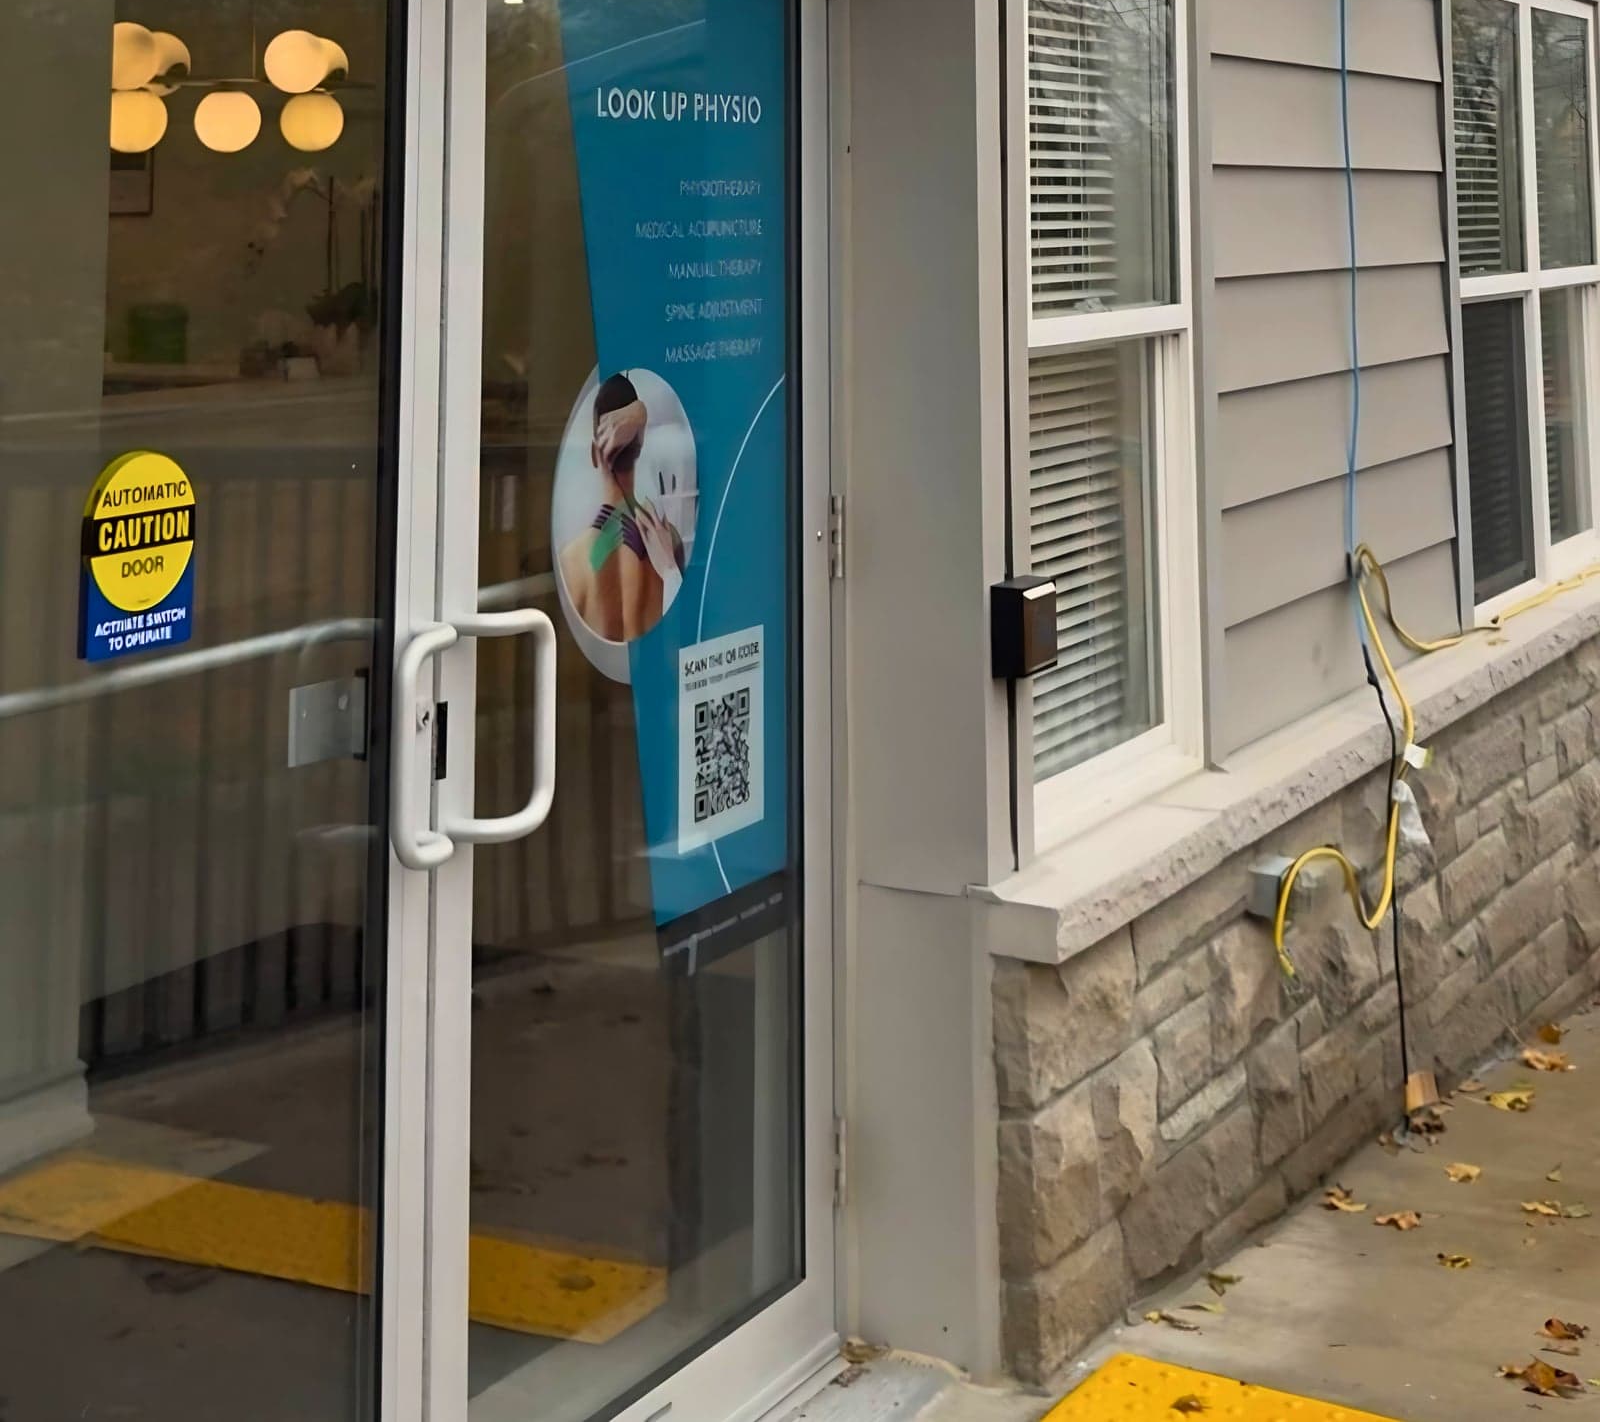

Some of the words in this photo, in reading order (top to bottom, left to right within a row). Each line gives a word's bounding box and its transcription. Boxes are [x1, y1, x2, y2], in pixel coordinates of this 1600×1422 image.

[597, 86, 656, 121] LOOK
[663, 90, 687, 121] UP
[694, 92, 761, 124] PHYSIO
[635, 221, 685, 239] MEDICAL
[665, 303, 695, 321] SPINE
[665, 342, 716, 363] MASSAGE
[102, 480, 187, 508] AUTOMATIC
[99, 509, 190, 552] CAUTION
[121, 555, 164, 579] DOOR
[95, 614, 145, 638] ACTIVATE
[146, 607, 186, 627] SWITCH
[108, 636, 124, 651] TO
[125, 625, 172, 650] OPERATE
[684, 658, 708, 677] SCAN
